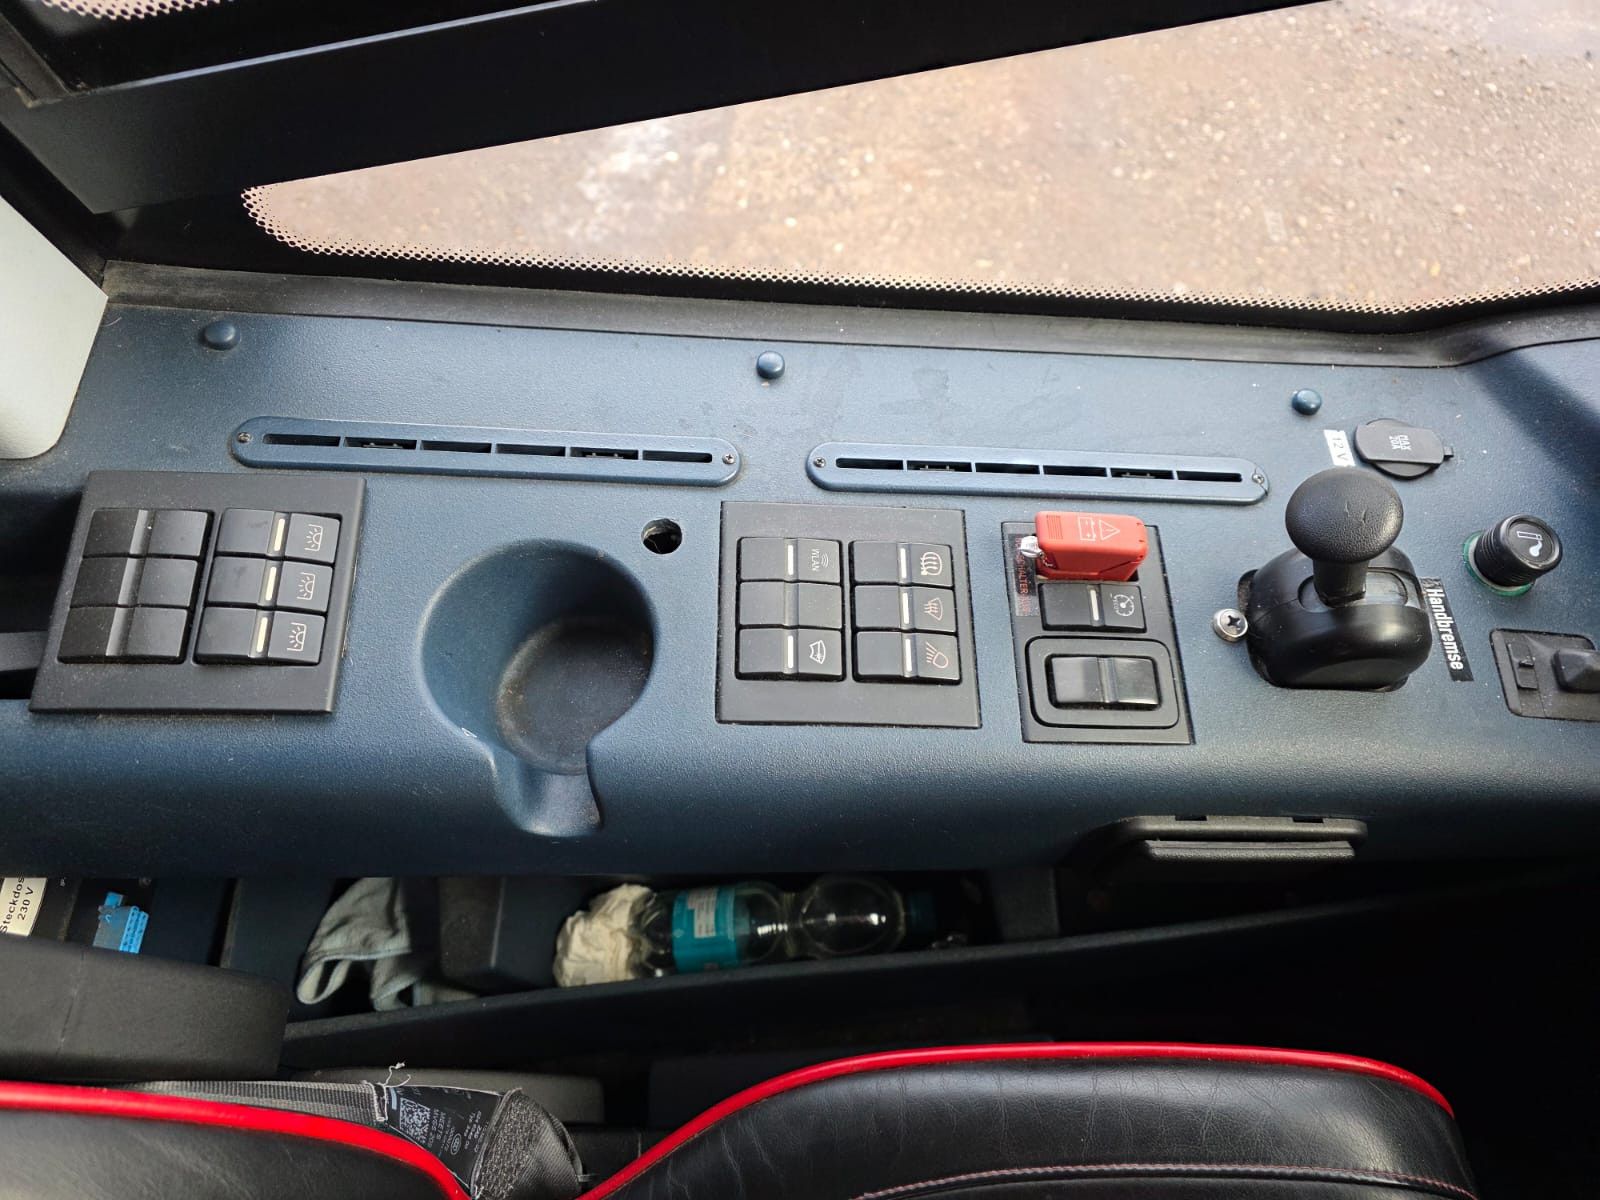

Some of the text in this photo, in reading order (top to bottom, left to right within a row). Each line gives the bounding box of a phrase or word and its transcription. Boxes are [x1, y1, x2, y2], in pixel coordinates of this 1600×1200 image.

[1332, 437, 1344, 449] 12
[811, 548, 820, 571] WLAN
[1427, 588, 1464, 671] Handbremse
[17, 886, 34, 921] 230 V
